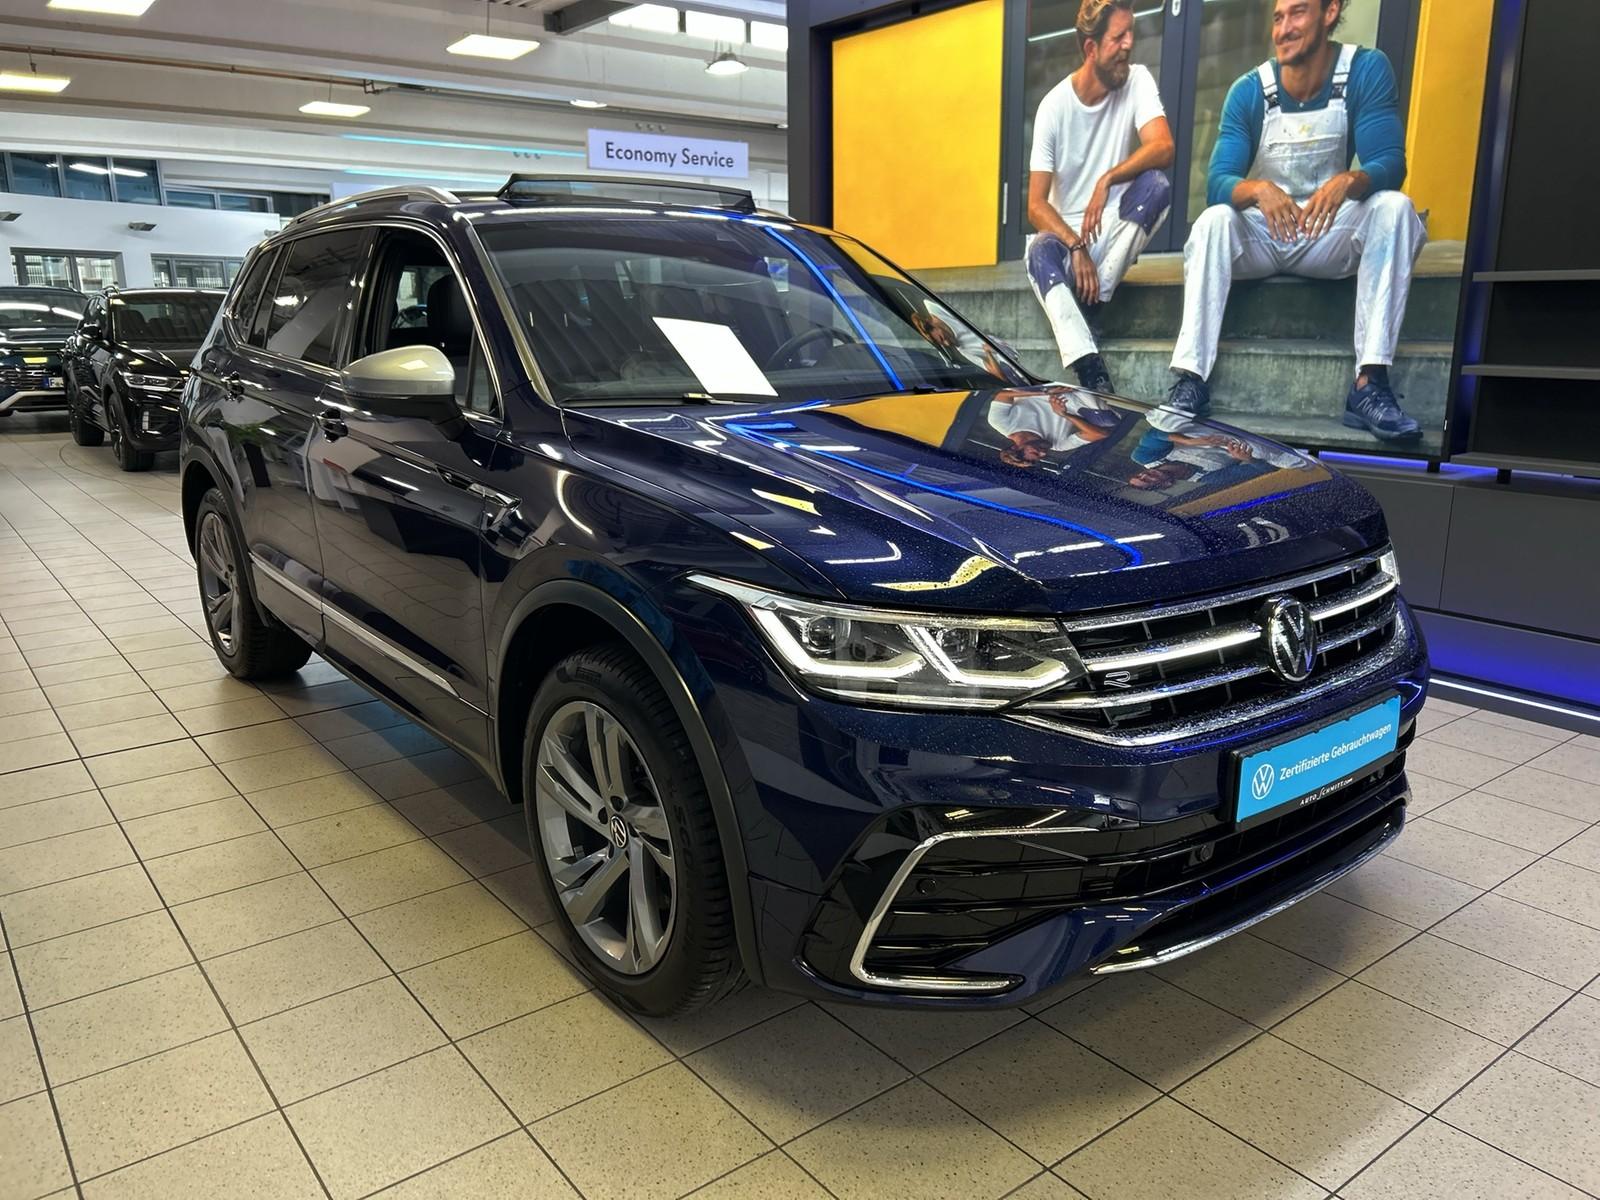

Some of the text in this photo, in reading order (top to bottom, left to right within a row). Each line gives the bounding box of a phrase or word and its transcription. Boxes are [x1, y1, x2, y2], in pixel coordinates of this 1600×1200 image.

[605, 141, 734, 168] Economy Service
[1280, 723, 1392, 781] Zertifizierte Gebrauchtwagen
[1252, 764, 1275, 800] VW
